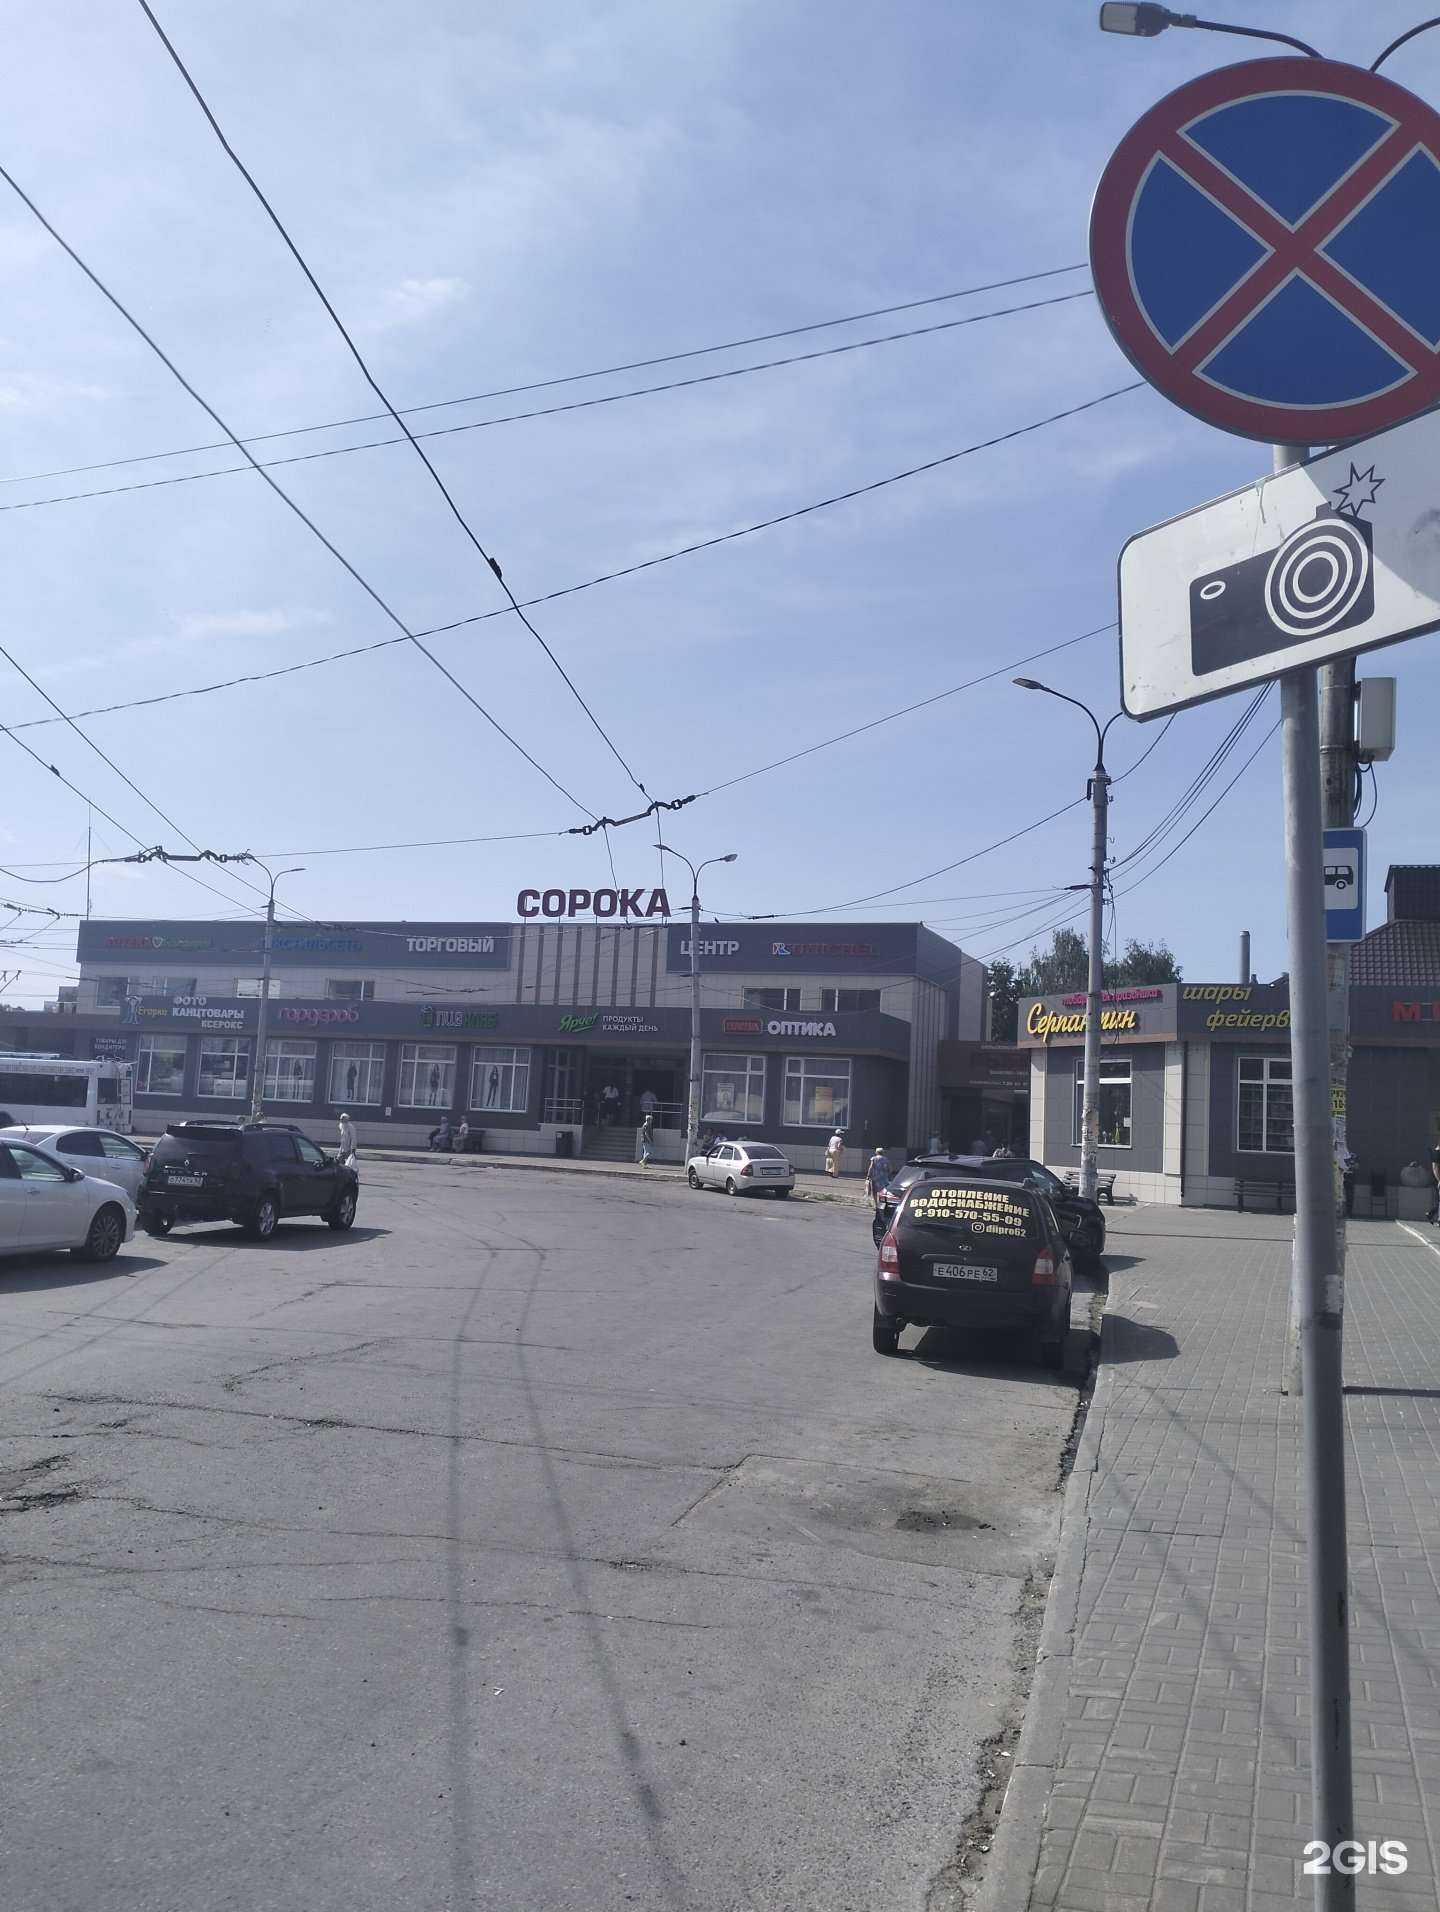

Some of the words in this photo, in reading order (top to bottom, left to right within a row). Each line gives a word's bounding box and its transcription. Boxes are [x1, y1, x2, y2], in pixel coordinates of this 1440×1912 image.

[517, 888, 671, 918] СОРОКА
[406, 935, 494, 953] ТОРГОВЫЙ
[173, 996, 207, 1006] ФОТО
[1183, 985, 1252, 1004] шары
[172, 1007, 245, 1019] КАНЦТОВАРЫ
[602, 1015, 644, 1023] ПРОДУКТЫ
[1206, 1009, 1292, 1032] фейерв
[201, 1020, 243, 1029] КСЕРОКС
[767, 1020, 836, 1036] ОПТИКА
[931, 1189, 1009, 1203] ОТОПЛЕНИЕ
[910, 1198, 1030, 1217] ВОДОСНАБЖЕНИЕ
[914, 1208, 1022, 1227] 8-910-570-55-09
